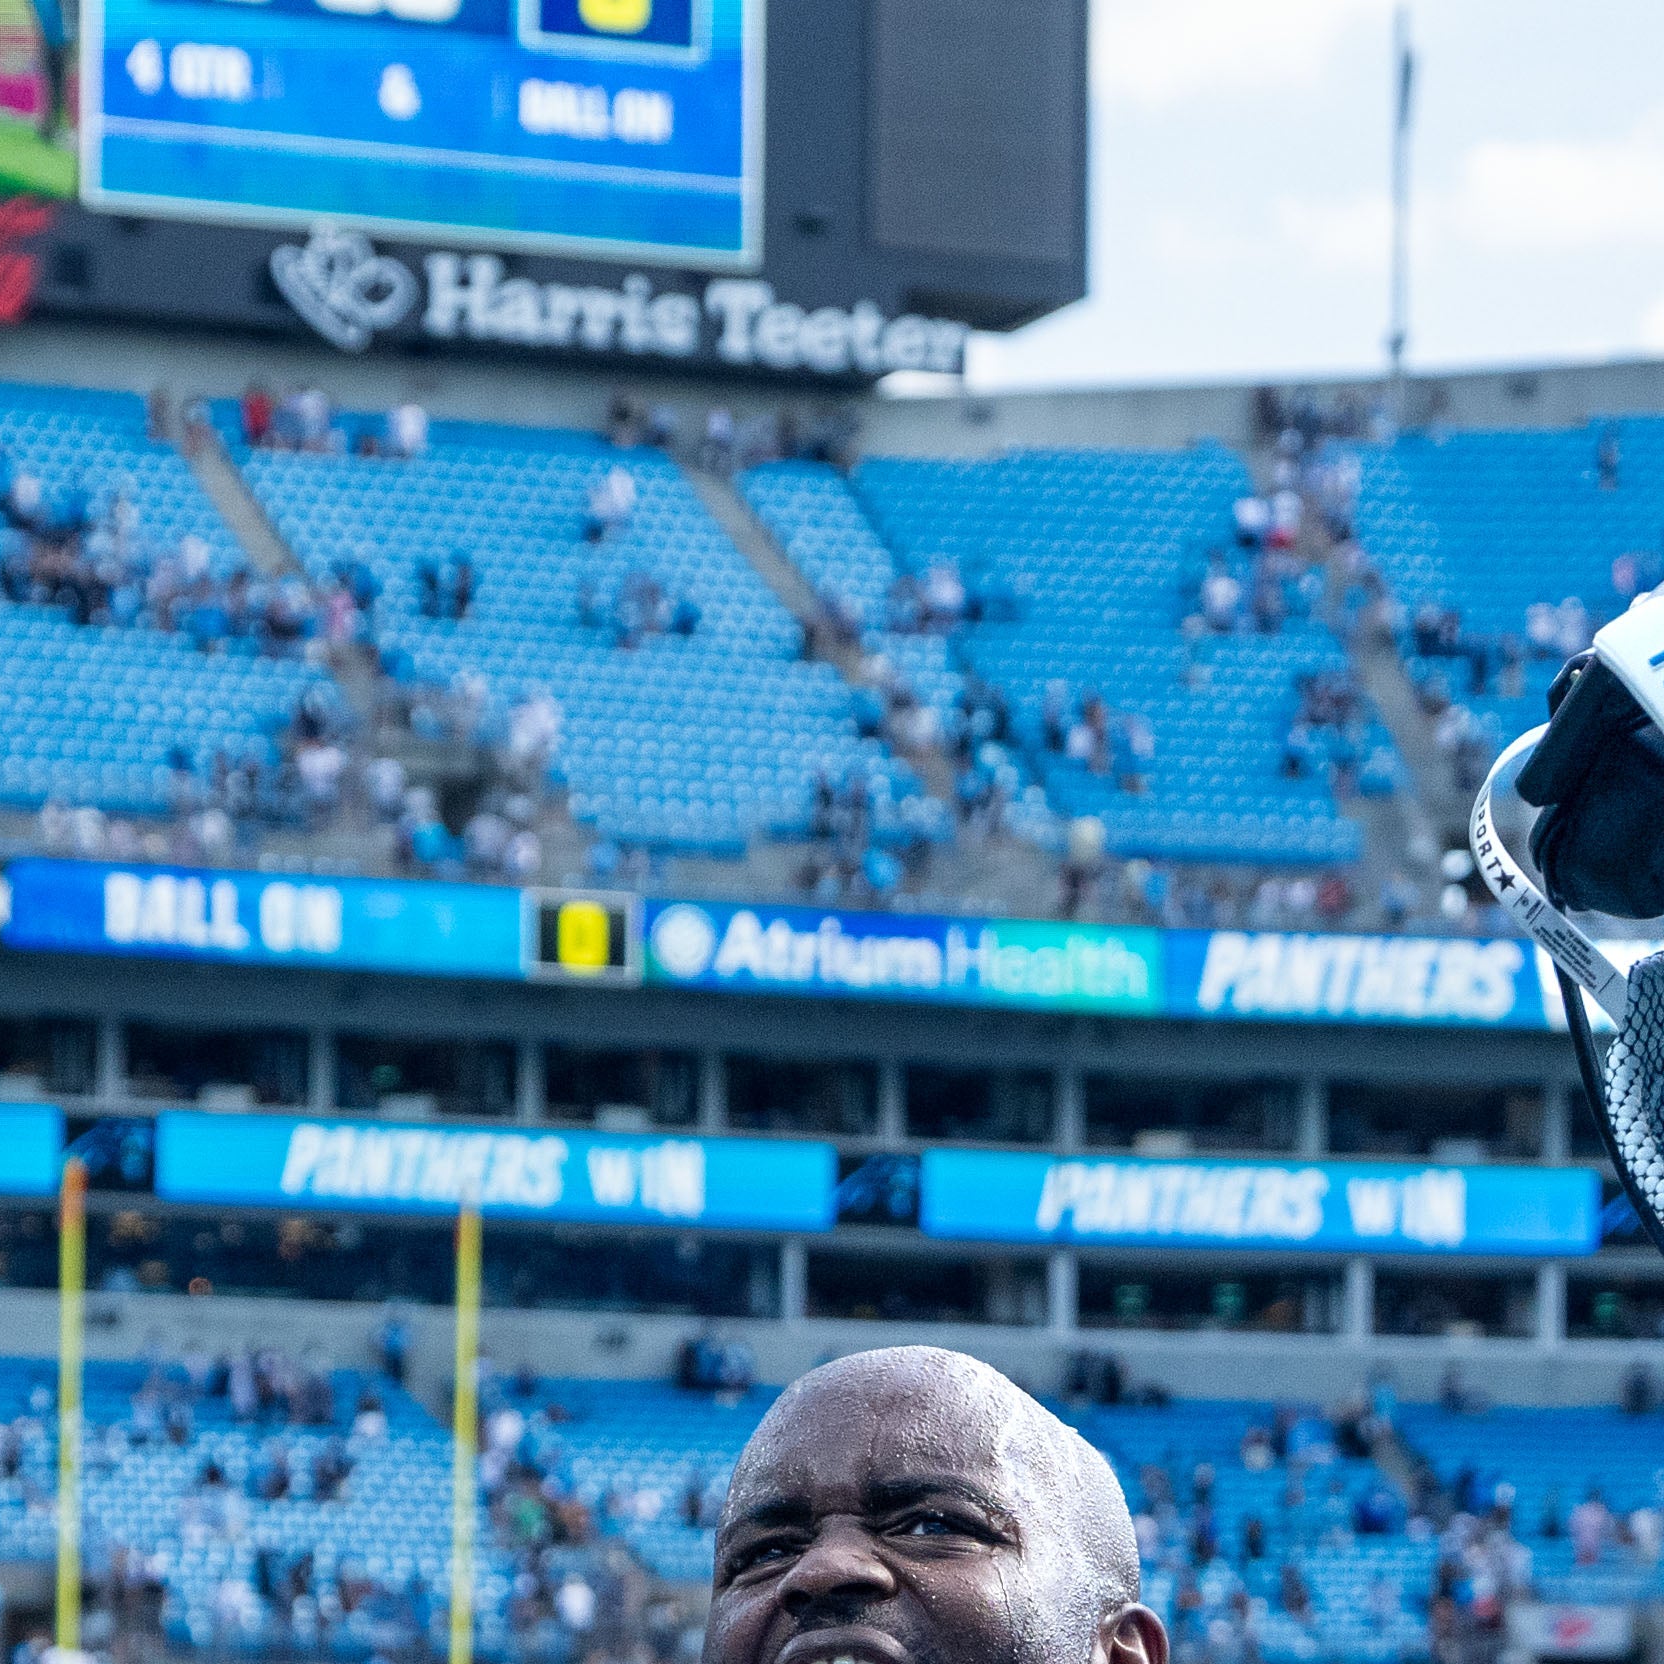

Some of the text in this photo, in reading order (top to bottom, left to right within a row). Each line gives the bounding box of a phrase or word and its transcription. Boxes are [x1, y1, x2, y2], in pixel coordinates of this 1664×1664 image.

[423, 252, 970, 373] Harris Teeter
[1198, 930, 1524, 1014] PANTHERS
[280, 1123, 706, 1218] PANTHERS WIN
[1036, 1162, 1467, 1247] PANTHERS WIN
